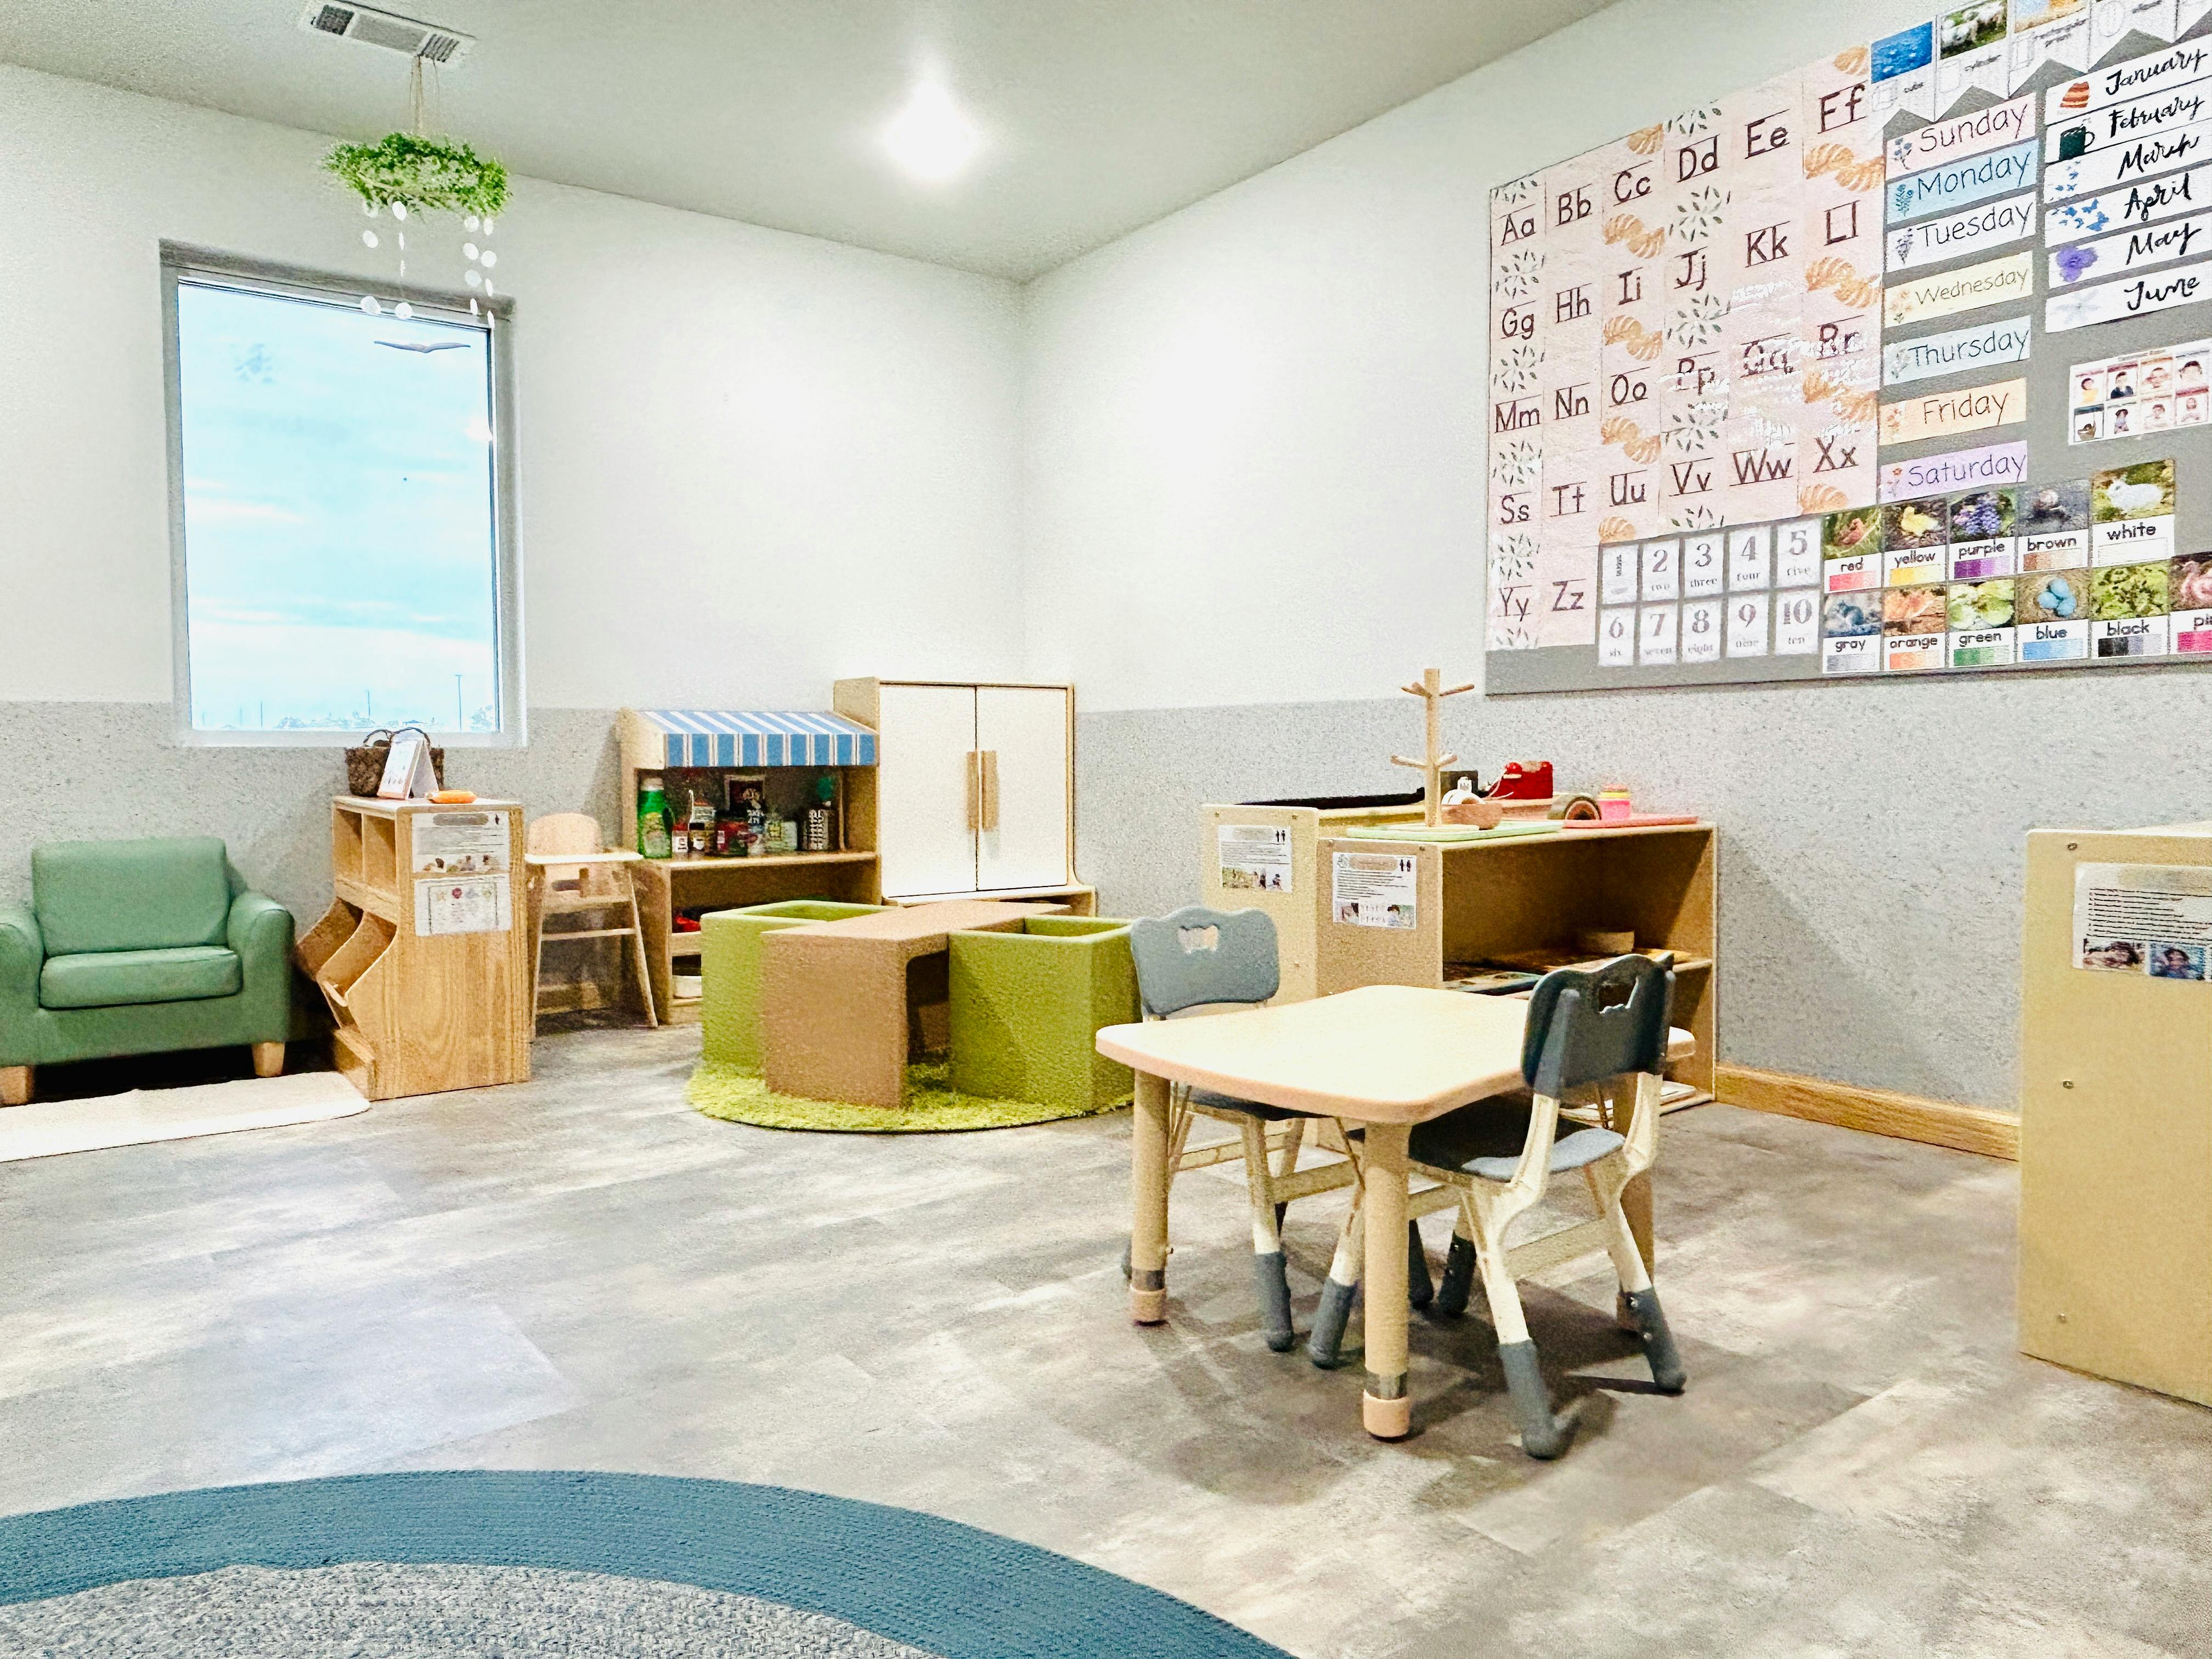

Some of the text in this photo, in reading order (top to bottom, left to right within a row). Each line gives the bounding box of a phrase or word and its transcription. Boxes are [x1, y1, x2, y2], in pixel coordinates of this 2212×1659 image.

[2106, 49, 2208, 95] January
[1820, 84, 1865, 132] Ff
[2110, 97, 2205, 138] February
[1747, 120, 1788, 158] Ee
[1920, 103, 2028, 153] Sunday
[1679, 136, 1719, 182] Dd
[2118, 133, 2200, 179] March
[1614, 171, 1651, 202] Cc
[1918, 151, 2032, 200] Monday
[1558, 189, 1591, 225] Bb
[2125, 173, 2192, 221] April
[1502, 213, 1536, 245] Aa
[1826, 202, 1858, 244] Ll
[1917, 202, 2033, 246] Tuesday
[1747, 227, 1788, 267] Kk
[2128, 222, 2202, 264] May
[1675, 251, 1707, 290] Jj
[1618, 270, 1641, 304] Ii
[1915, 267, 2029, 306] Wednesday
[2125, 276, 2199, 310] June
[1556, 287, 1590, 323] Hh
[1502, 310, 1534, 338] Gg
[1820, 324, 1859, 358] Rr
[1908, 329, 2030, 366] Thursday
[1611, 375, 1646, 404] Oo
[1678, 358, 1714, 394] Pp
[1496, 401, 1541, 432] Mm
[1555, 388, 1589, 419] Nn
[1923, 392, 2008, 425] Friday
[1733, 449, 1791, 483] Ww
[1814, 436, 1857, 472] Xx
[1671, 464, 1711, 494] Vv
[1909, 454, 2026, 486] Saturday
[1553, 486, 1584, 516] Tt
[1611, 476, 1645, 505] Uu
[1501, 495, 1529, 523] Ss
[1790, 530, 1808, 555] 5
[2028, 538, 2076, 551] brown
[2107, 522, 2156, 540] white
[1652, 550, 1668, 572] 2
[1695, 544, 1712, 567] 3
[1741, 536, 1758, 561] 4
[1894, 550, 1936, 568] yellow
[1959, 538, 2005, 560] purple
[1841, 557, 1864, 572] red
[1500, 588, 1529, 621] Yy
[1553, 582, 1583, 610] Zz
[1784, 599, 1812, 624] 10
[1609, 617, 1624, 638] 6
[1650, 613, 1665, 636] 7
[1692, 610, 1709, 633] 8
[1739, 604, 1756, 627] 9
[2107, 619, 2149, 636] black
[1835, 640, 1865, 652] gray
[1890, 637, 1937, 649] orange
[1959, 632, 2001, 647] green
[2036, 625, 2067, 640] blue
